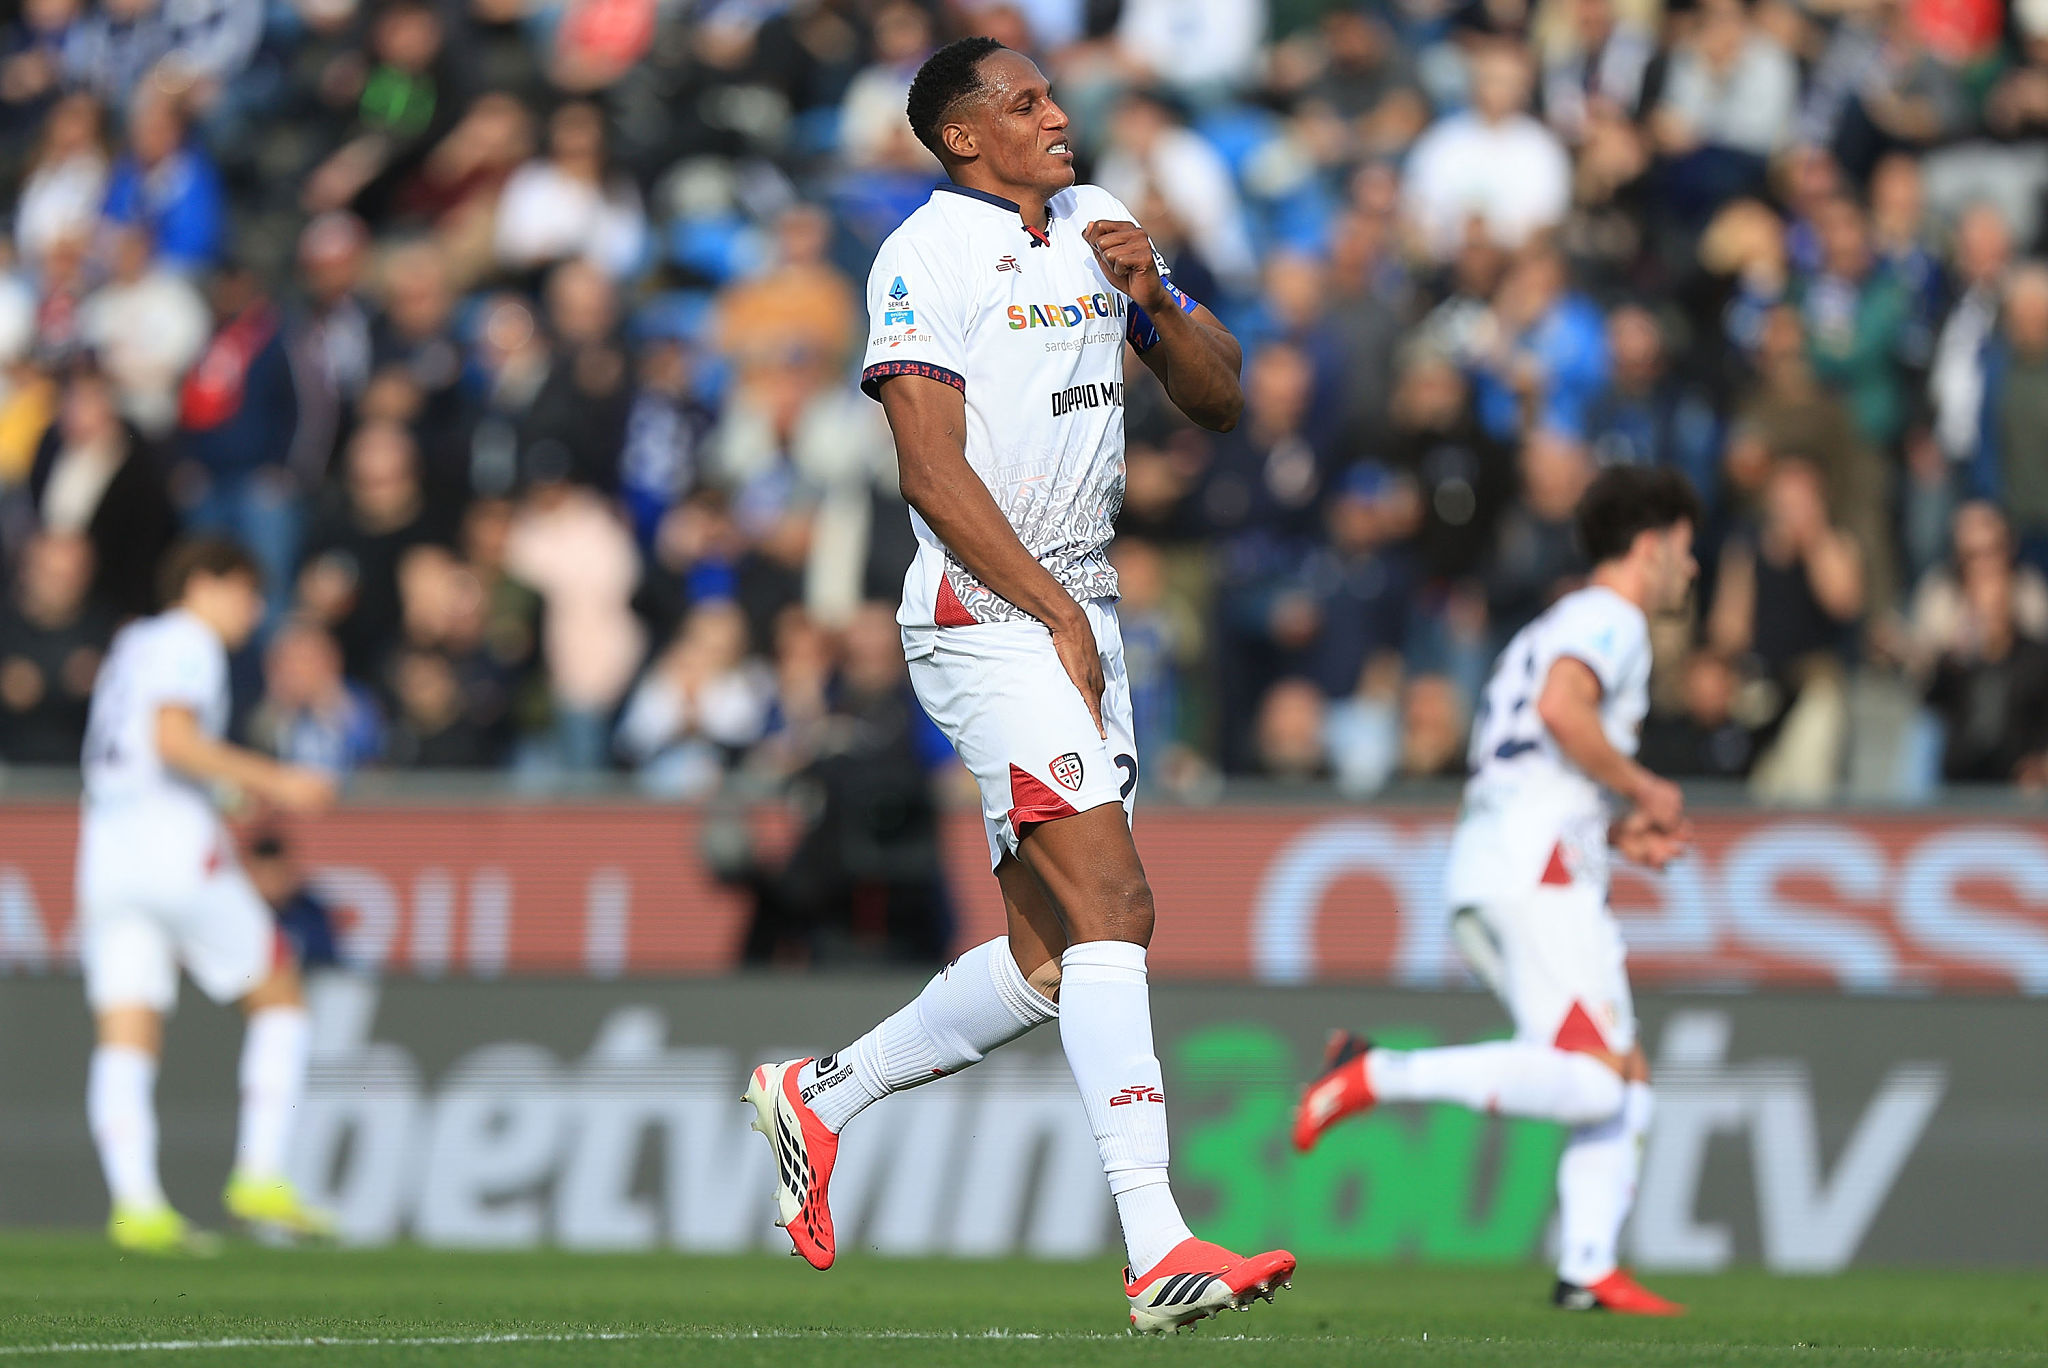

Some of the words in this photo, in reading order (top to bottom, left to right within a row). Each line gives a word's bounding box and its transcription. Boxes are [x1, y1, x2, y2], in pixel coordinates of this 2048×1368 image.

[1007, 292, 1127, 330] SARDEGNA
[872, 336, 887, 346] KEEP
[1051, 383, 1099, 417] DOPPIO
[810, 1062, 854, 1096] TAPEDESIG
